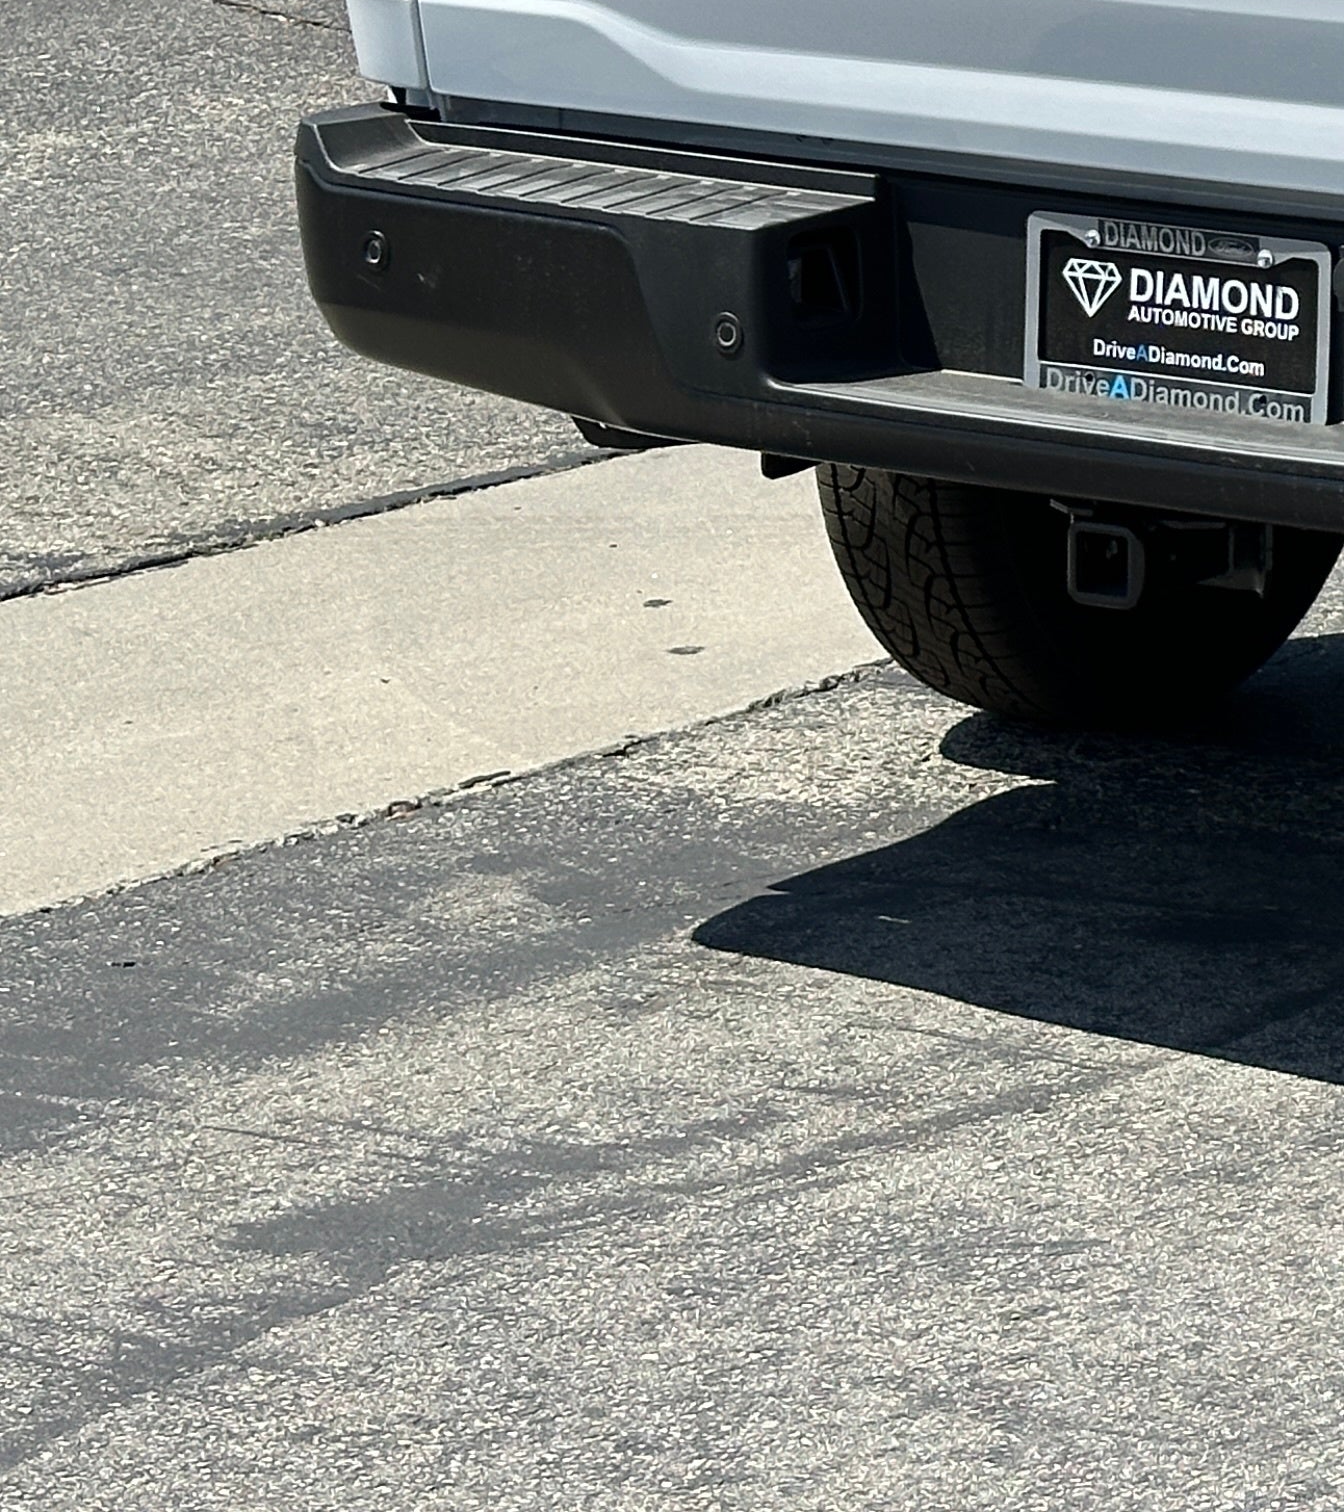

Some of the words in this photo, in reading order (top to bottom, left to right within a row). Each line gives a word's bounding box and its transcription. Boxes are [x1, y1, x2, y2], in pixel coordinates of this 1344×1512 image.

[1103, 222, 1206, 257] DIAMOND
[1130, 268, 1300, 321] DIAMOND
[1127, 307, 1238, 334] AUTOMOTIVE
[1241, 321, 1300, 341] GROUP
[1093, 339, 1265, 377] DriveADiamond.Com
[1046, 367, 1305, 424] DriveADiamond.Com
